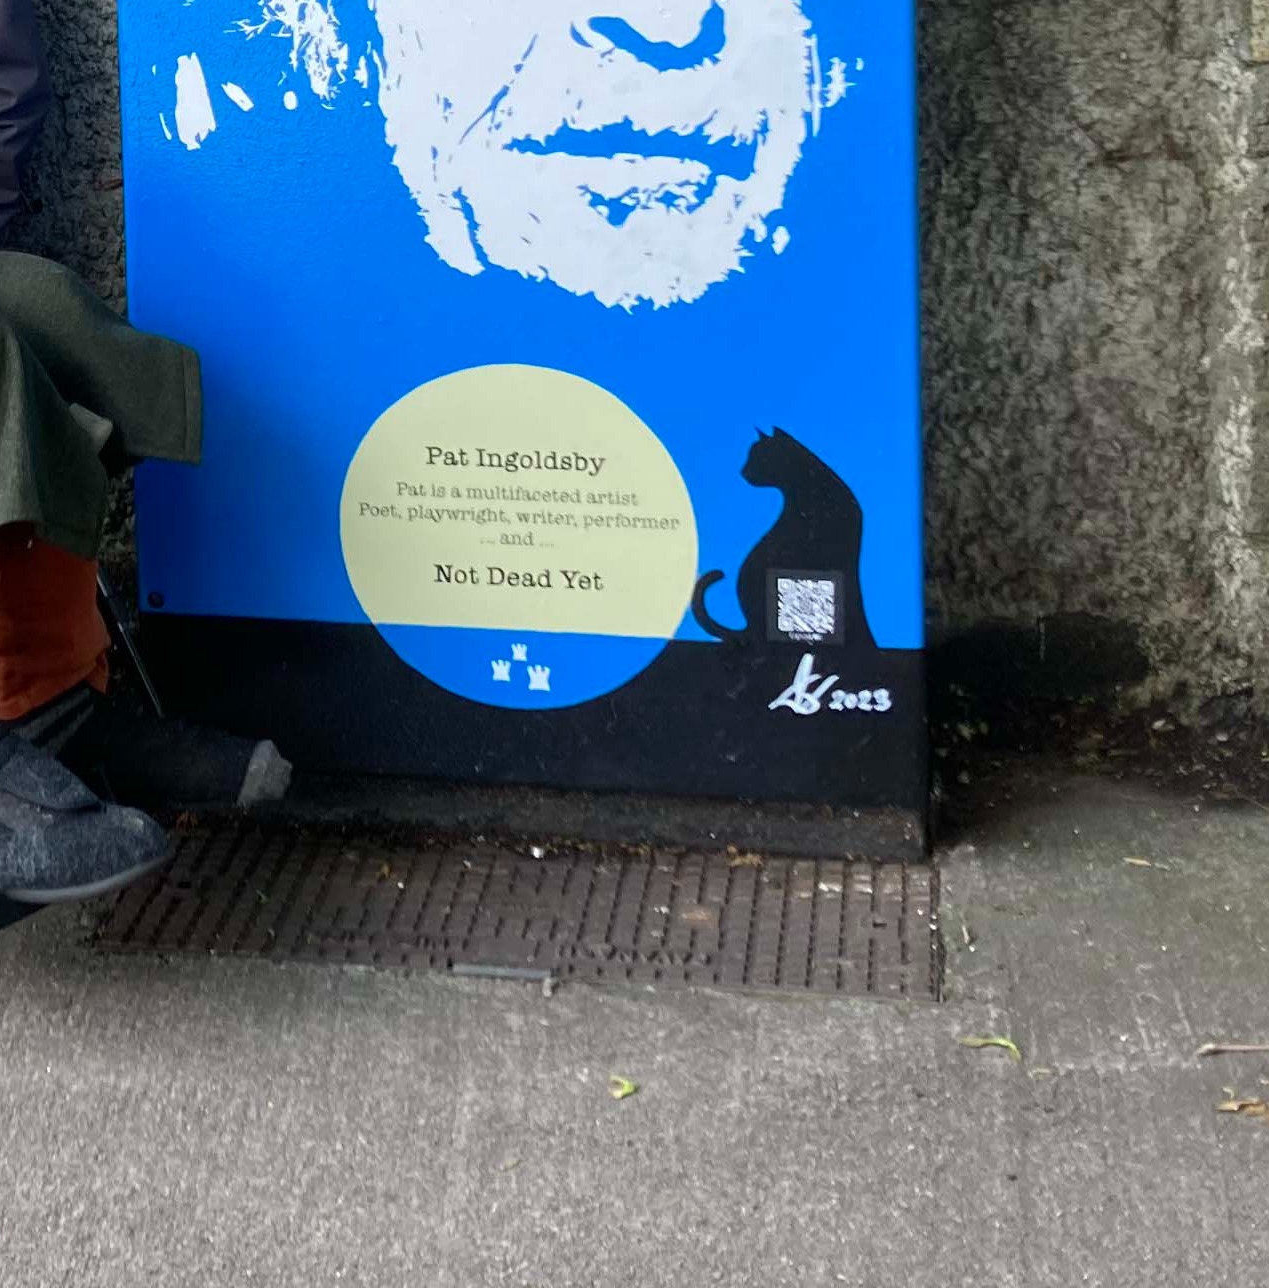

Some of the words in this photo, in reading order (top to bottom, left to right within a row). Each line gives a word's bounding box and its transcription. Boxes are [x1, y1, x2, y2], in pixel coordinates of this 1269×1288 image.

[424, 445, 470, 467] Pat
[474, 447, 607, 477] Ingoldsby
[396, 481, 427, 497] Pat
[431, 483, 446, 498] is
[450, 486, 463, 499] a
[465, 485, 583, 505] multifaceted
[586, 490, 639, 507] artist
[358, 501, 403, 520] Poet,
[406, 503, 512, 526] playwright,
[515, 509, 579, 528] writer,
[582, 512, 681, 531] performer
[498, 530, 535, 547] and
[433, 563, 480, 586] Not
[485, 565, 554, 590] Dead
[558, 569, 605, 592] Yet
[828, 688, 892, 712] 2023
